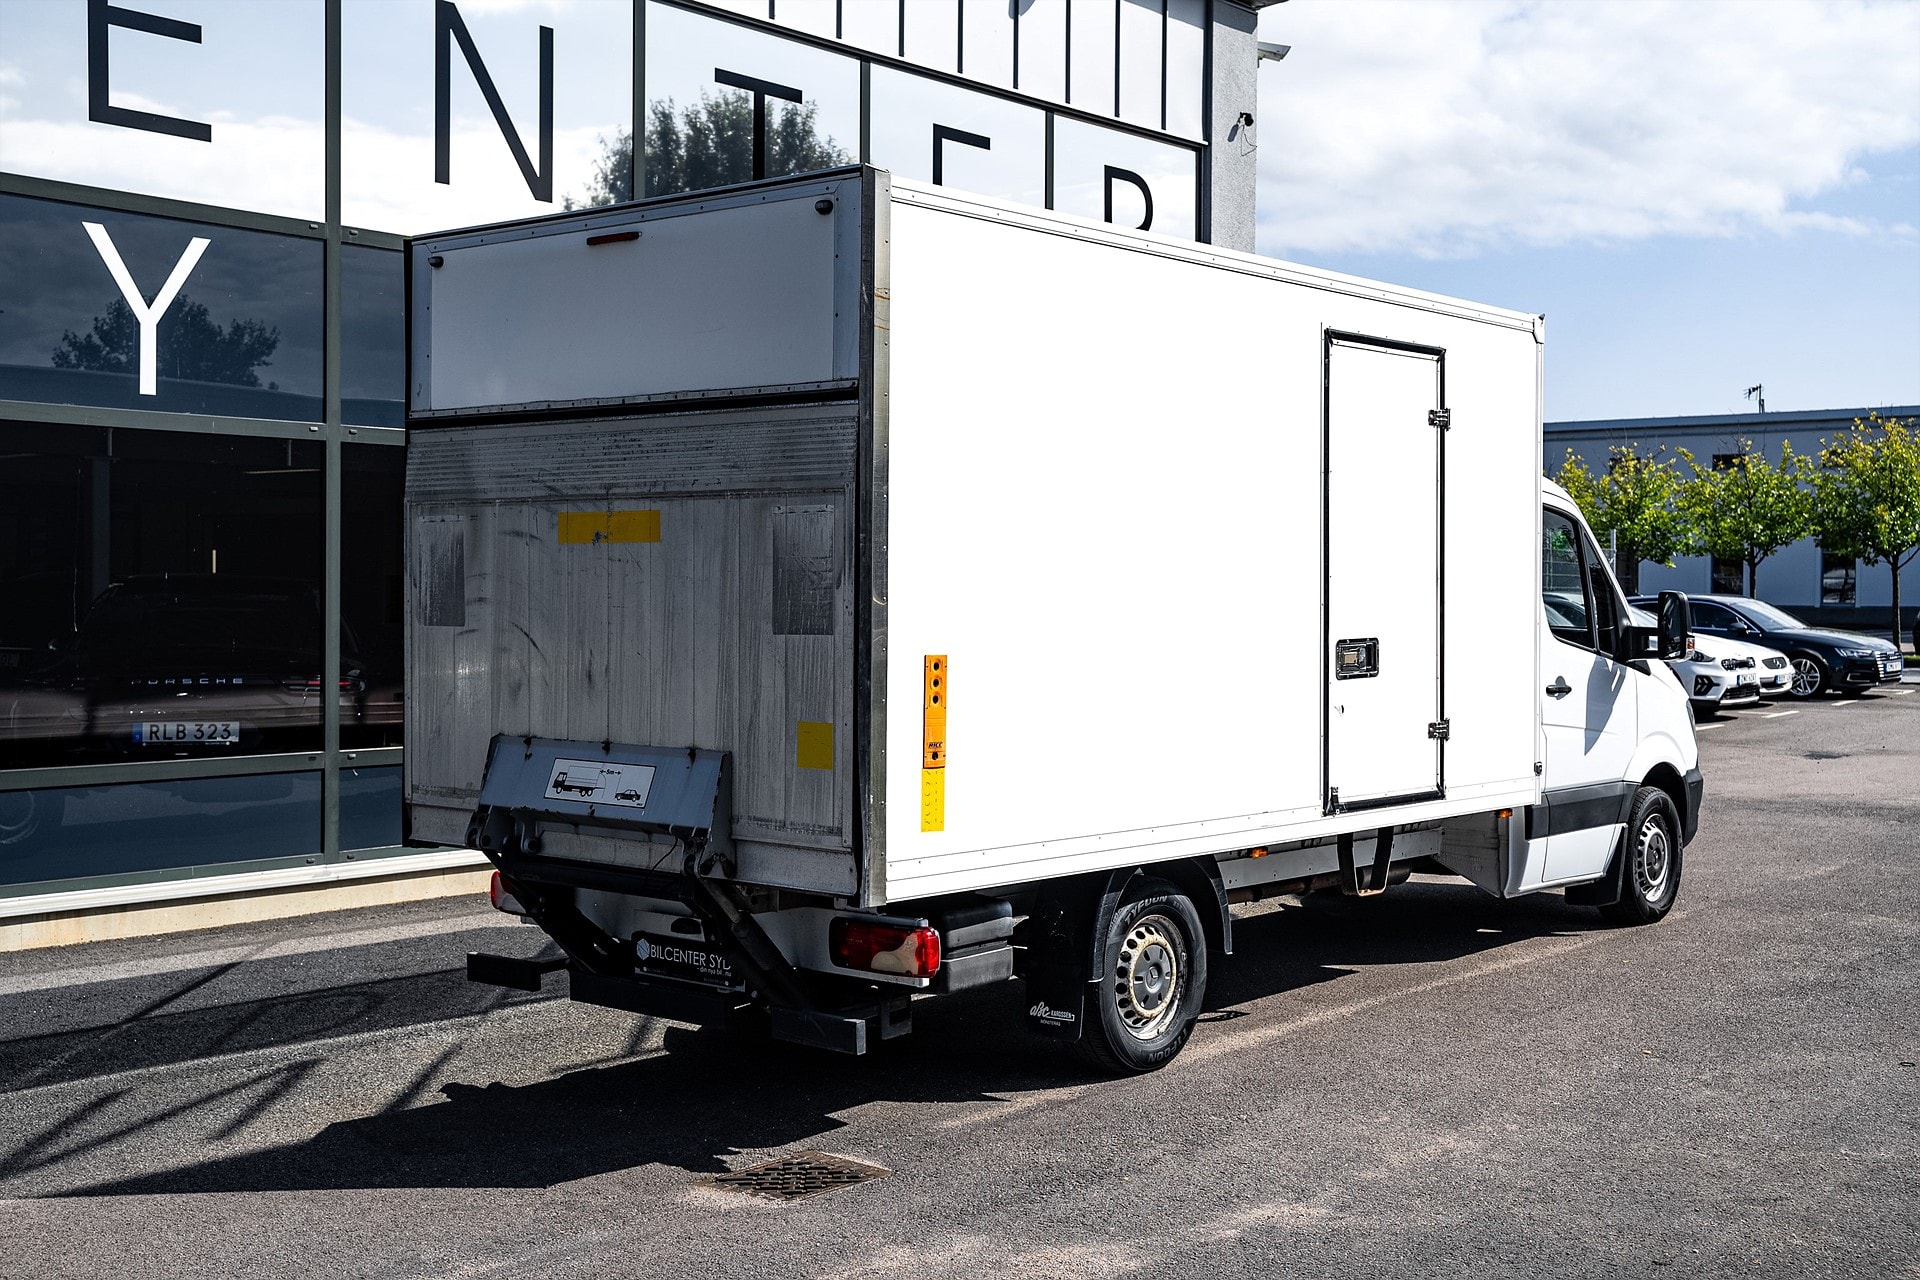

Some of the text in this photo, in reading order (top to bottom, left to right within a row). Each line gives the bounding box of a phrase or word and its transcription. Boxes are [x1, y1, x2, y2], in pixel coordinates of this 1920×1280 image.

[149, 723, 232, 741] RLB 323
[650, 944, 707, 967] BILCENTER
